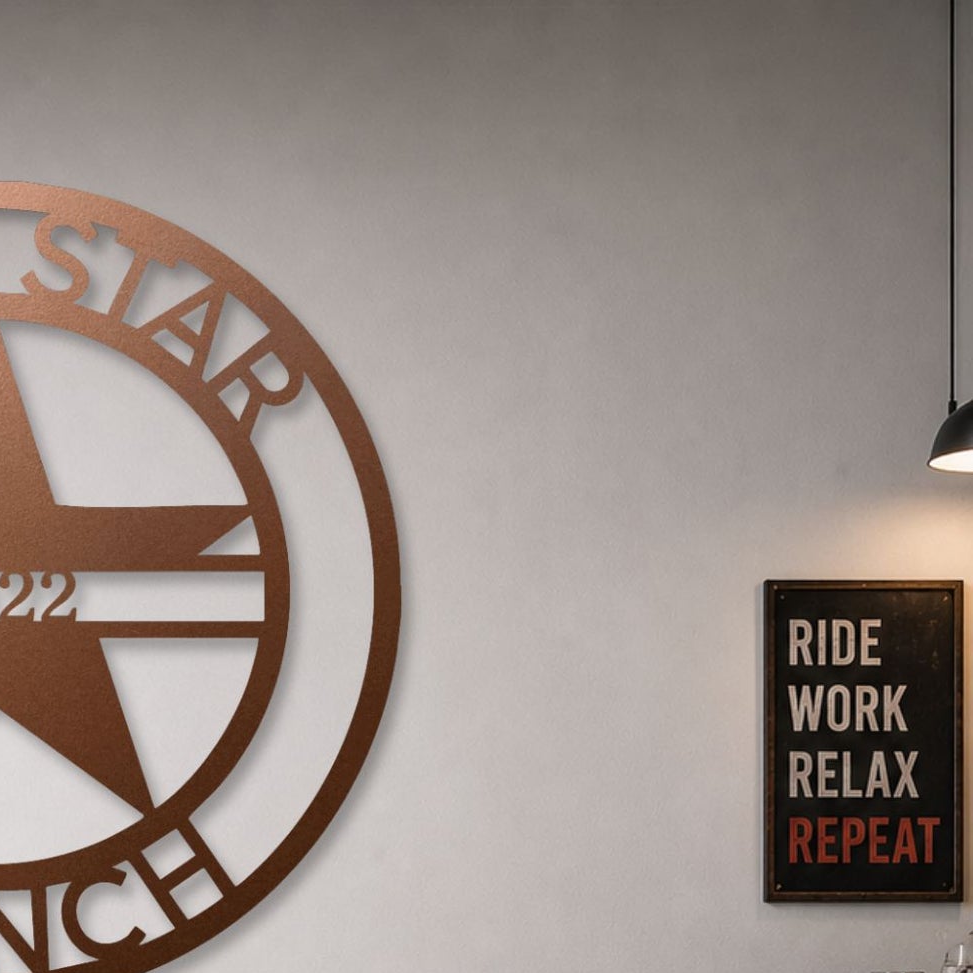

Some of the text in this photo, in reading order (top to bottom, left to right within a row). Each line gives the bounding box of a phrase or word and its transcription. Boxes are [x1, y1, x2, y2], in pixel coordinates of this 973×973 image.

[20, 212, 305, 440] STAR
[789, 618, 882, 667] RIDE
[787, 684, 909, 732] WORK
[789, 751, 920, 799] RELAX
[788, 817, 941, 864] REPEAT
